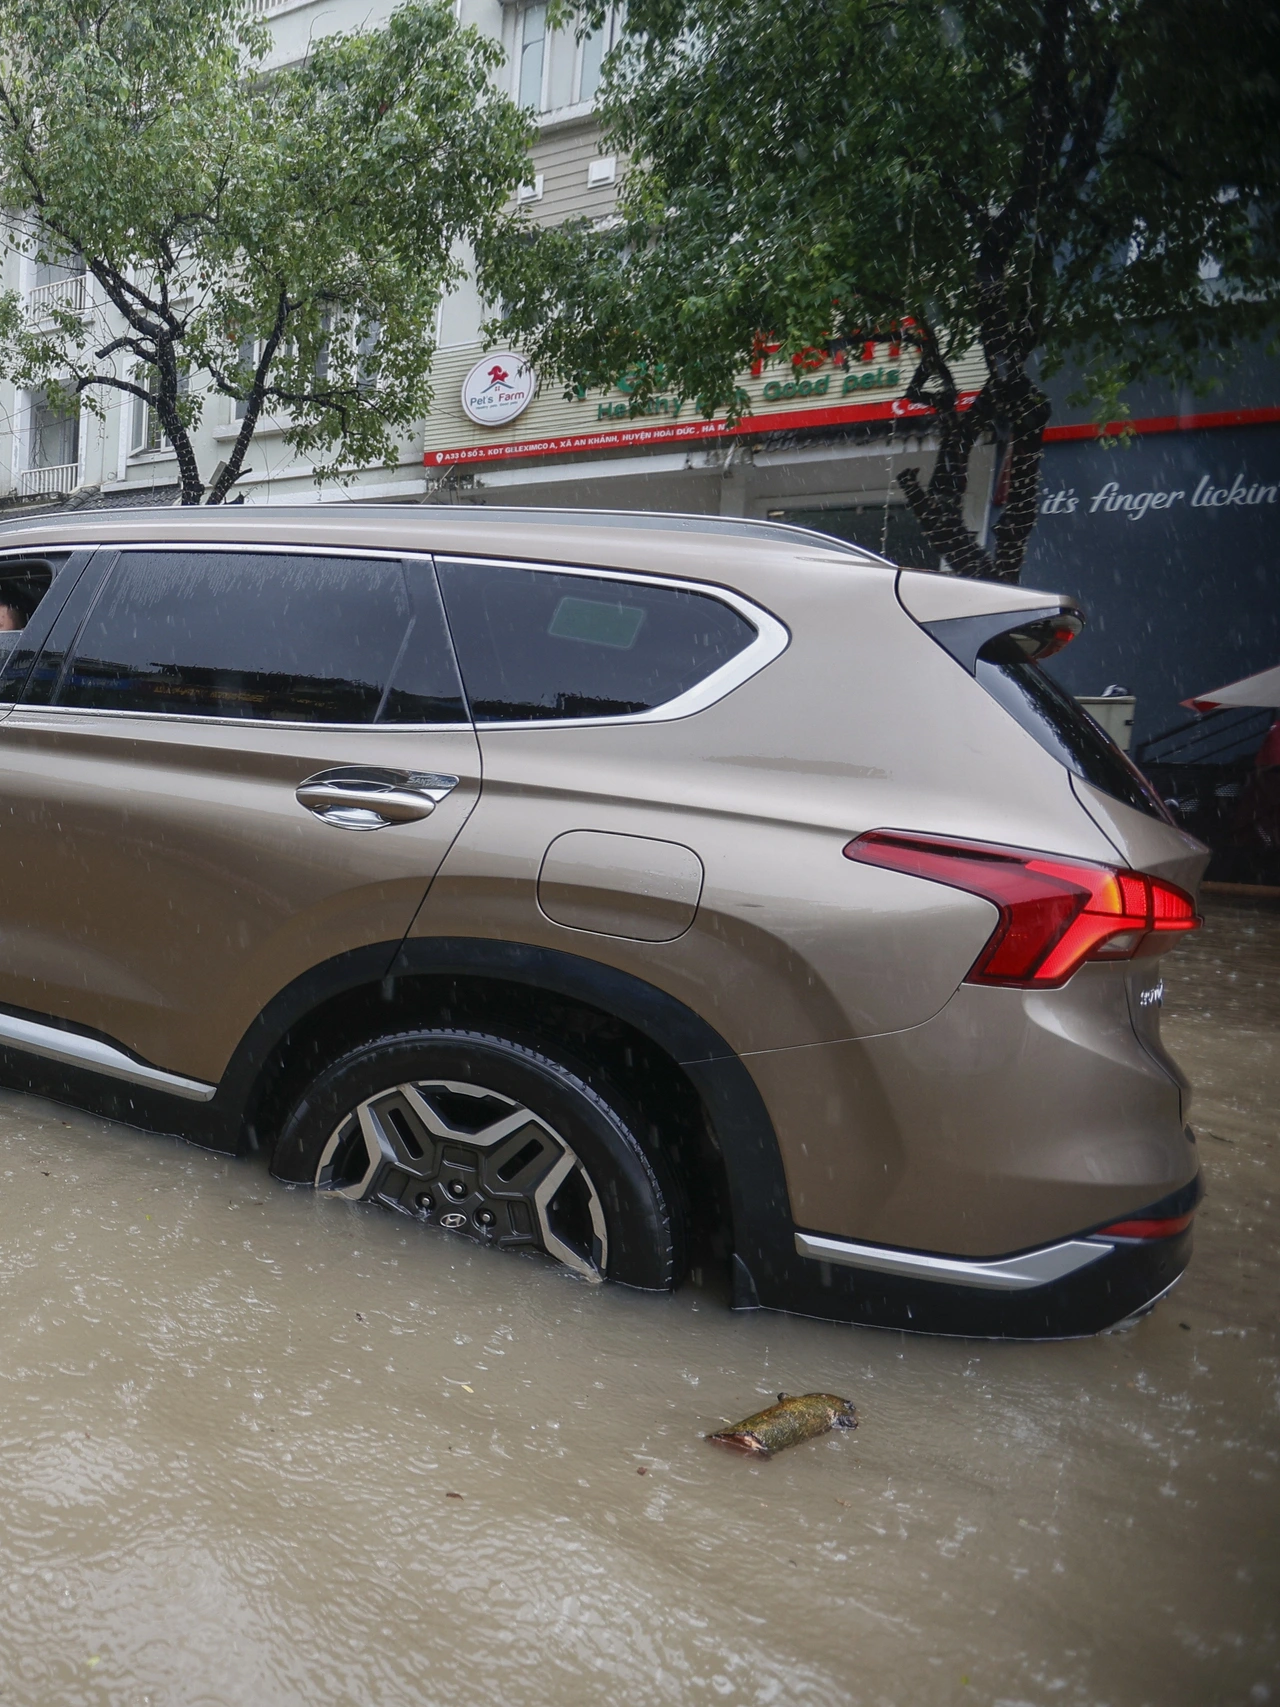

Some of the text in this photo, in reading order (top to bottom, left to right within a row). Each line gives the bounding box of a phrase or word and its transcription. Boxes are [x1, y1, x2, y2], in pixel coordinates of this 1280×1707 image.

[763, 375, 830, 400] Good
[842, 367, 900, 396] pets
[470, 396, 494, 406] Pet's
[498, 391, 525, 402] Farm
[573, 438, 586, 446] AN
[702, 423, 716, 432] HÀ
[1088, 481, 1185, 521] finger
